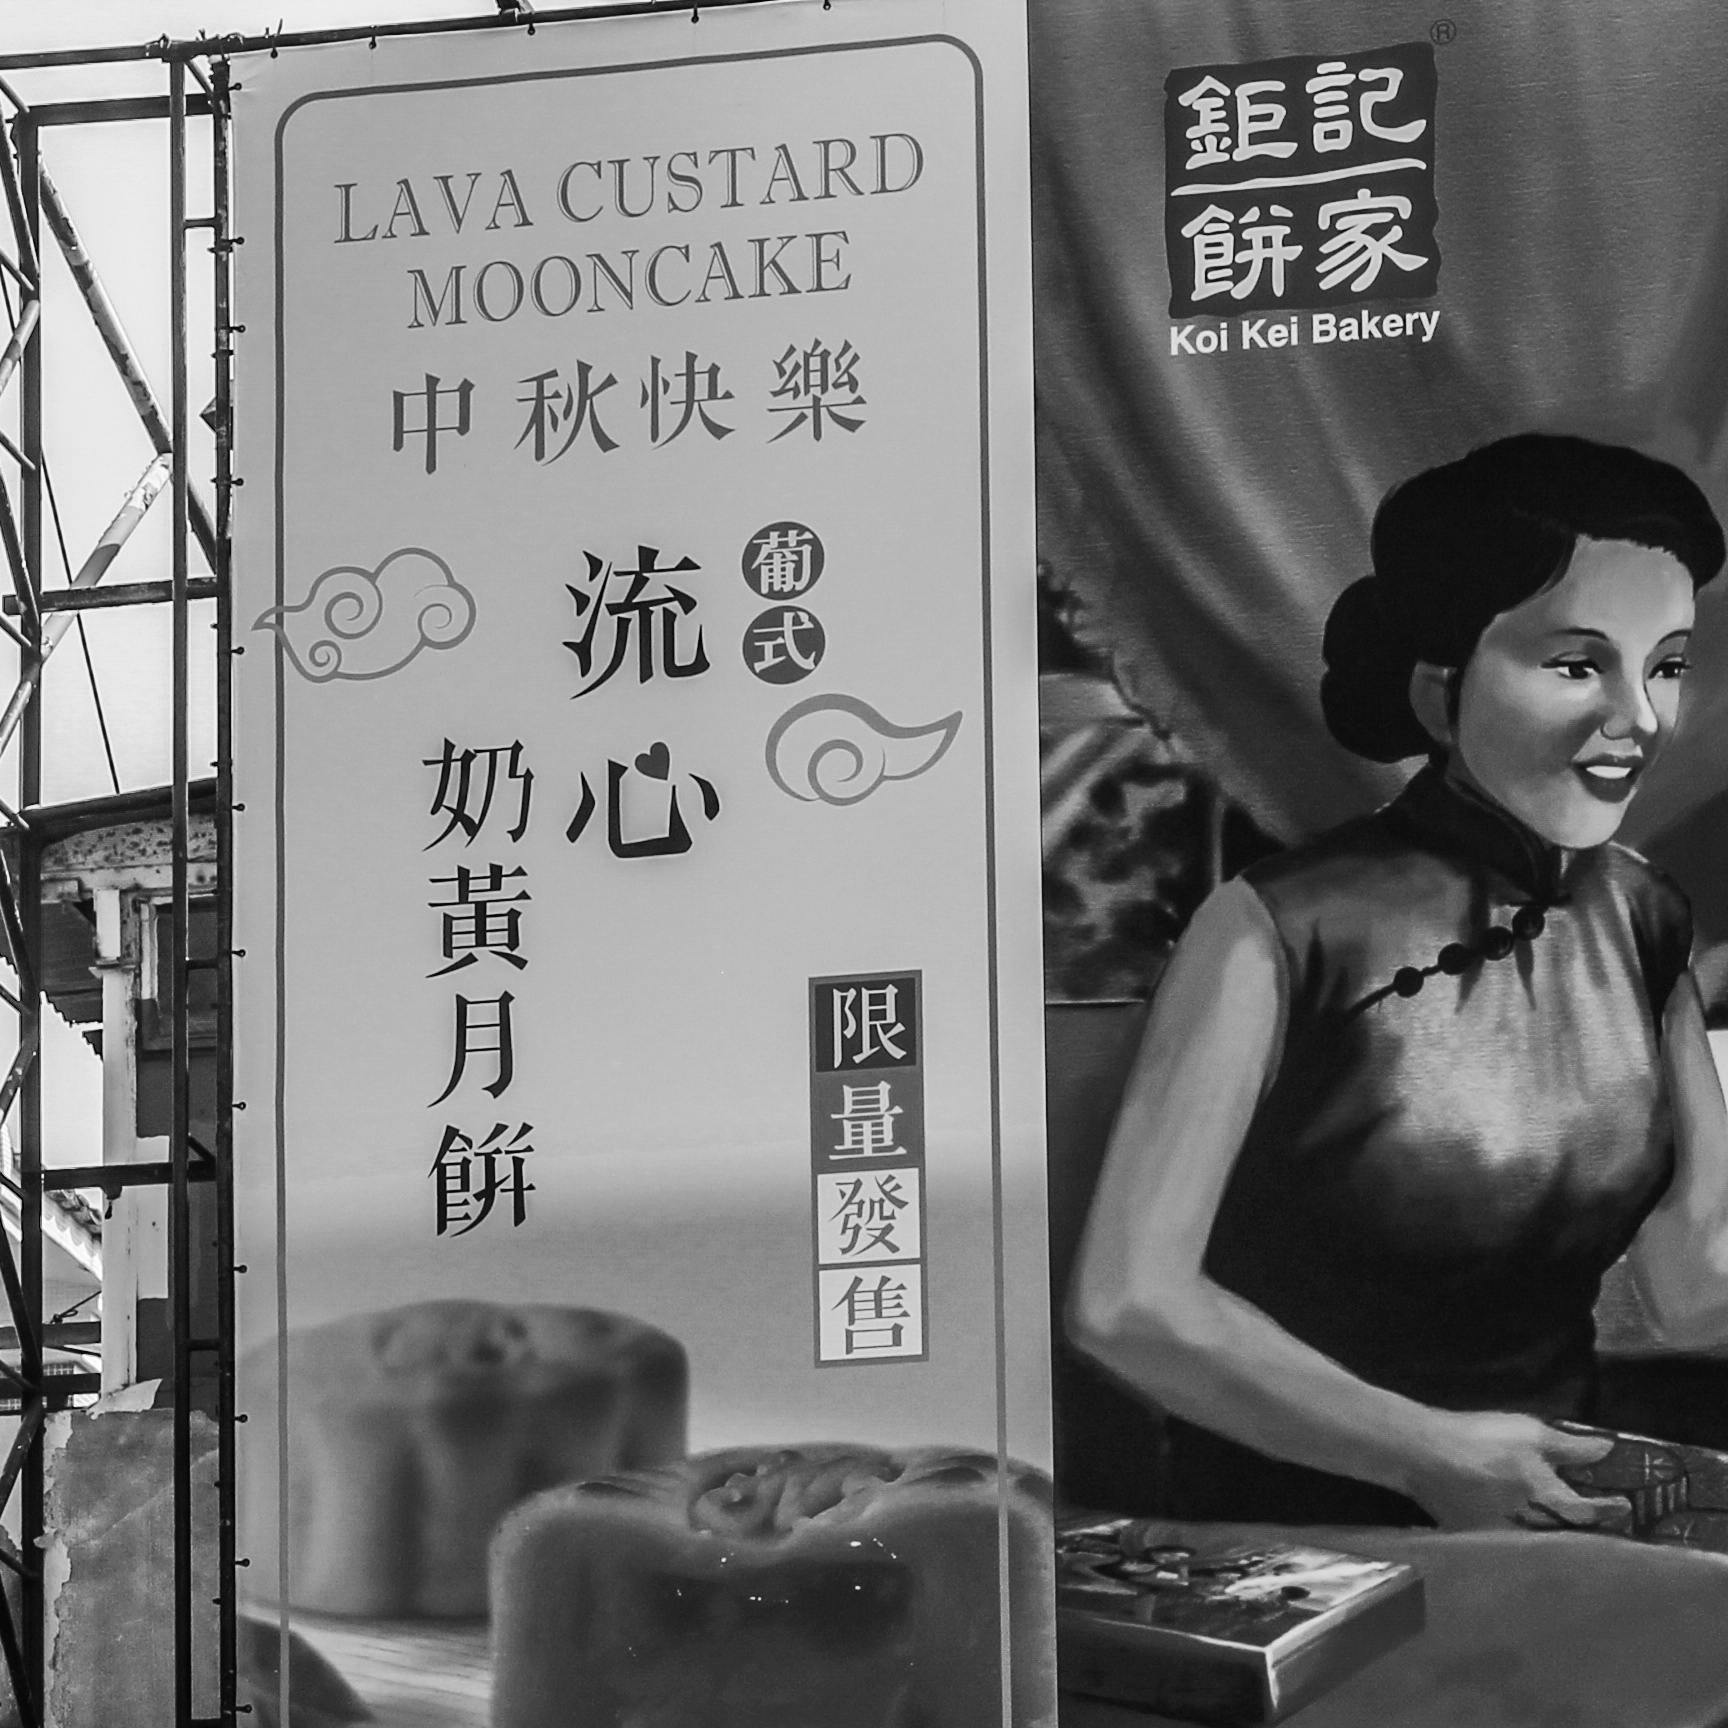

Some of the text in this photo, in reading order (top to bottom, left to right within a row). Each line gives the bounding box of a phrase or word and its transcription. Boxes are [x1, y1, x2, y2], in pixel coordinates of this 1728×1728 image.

[1178, 61, 1427, 170] 鉅記
[333, 131, 927, 246] LAVA CUSTARD
[406, 231, 854, 330] MOONCAKE
[1170, 310, 1441, 355] Koi Kei Bakery
[389, 340, 869, 476] 中秋快樂
[561, 544, 723, 863] 流心
[828, 982, 912, 1358] 限量發售
